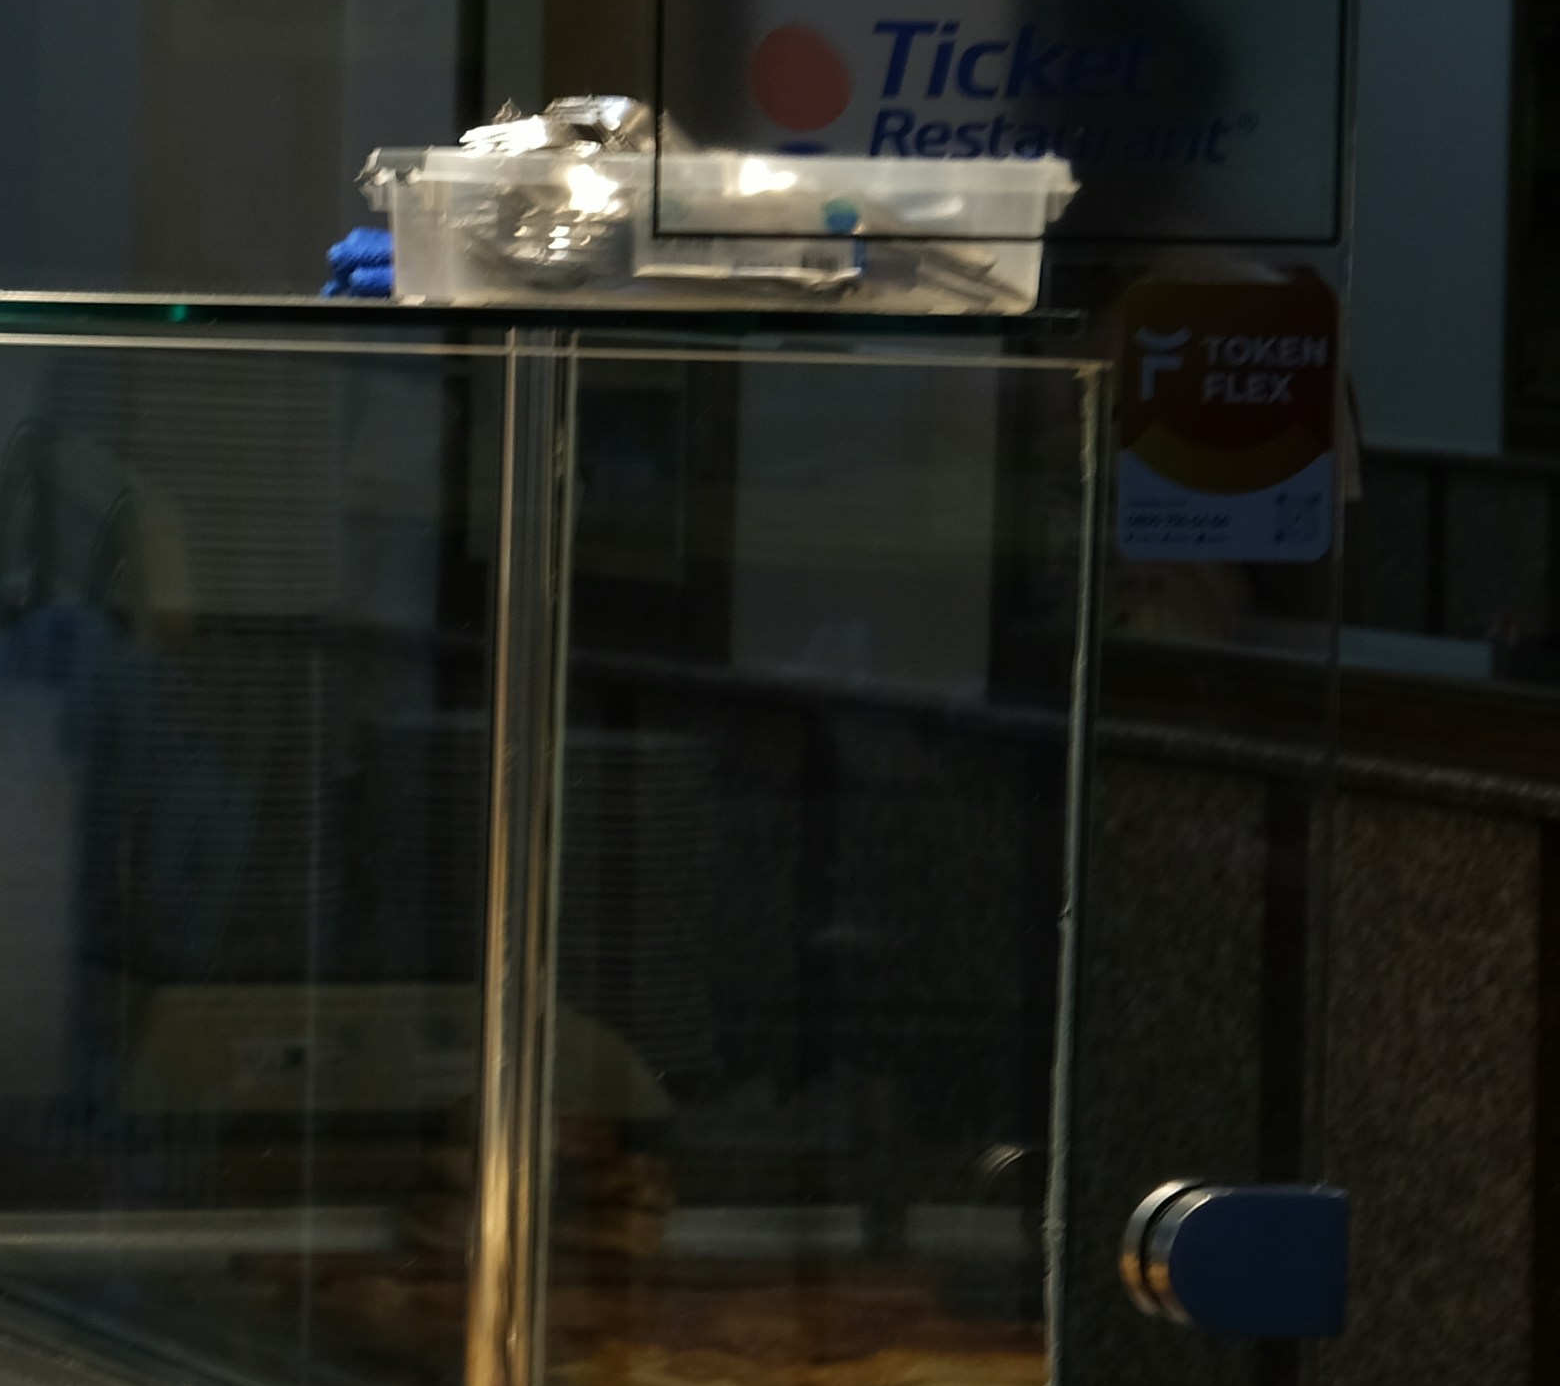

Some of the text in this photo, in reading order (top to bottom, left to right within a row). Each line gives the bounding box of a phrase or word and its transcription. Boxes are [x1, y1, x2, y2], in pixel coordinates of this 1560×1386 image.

[869, 19, 1163, 100] Ticket
[1200, 334, 1329, 368] TOKEN
[1200, 371, 1296, 405] FLEX
